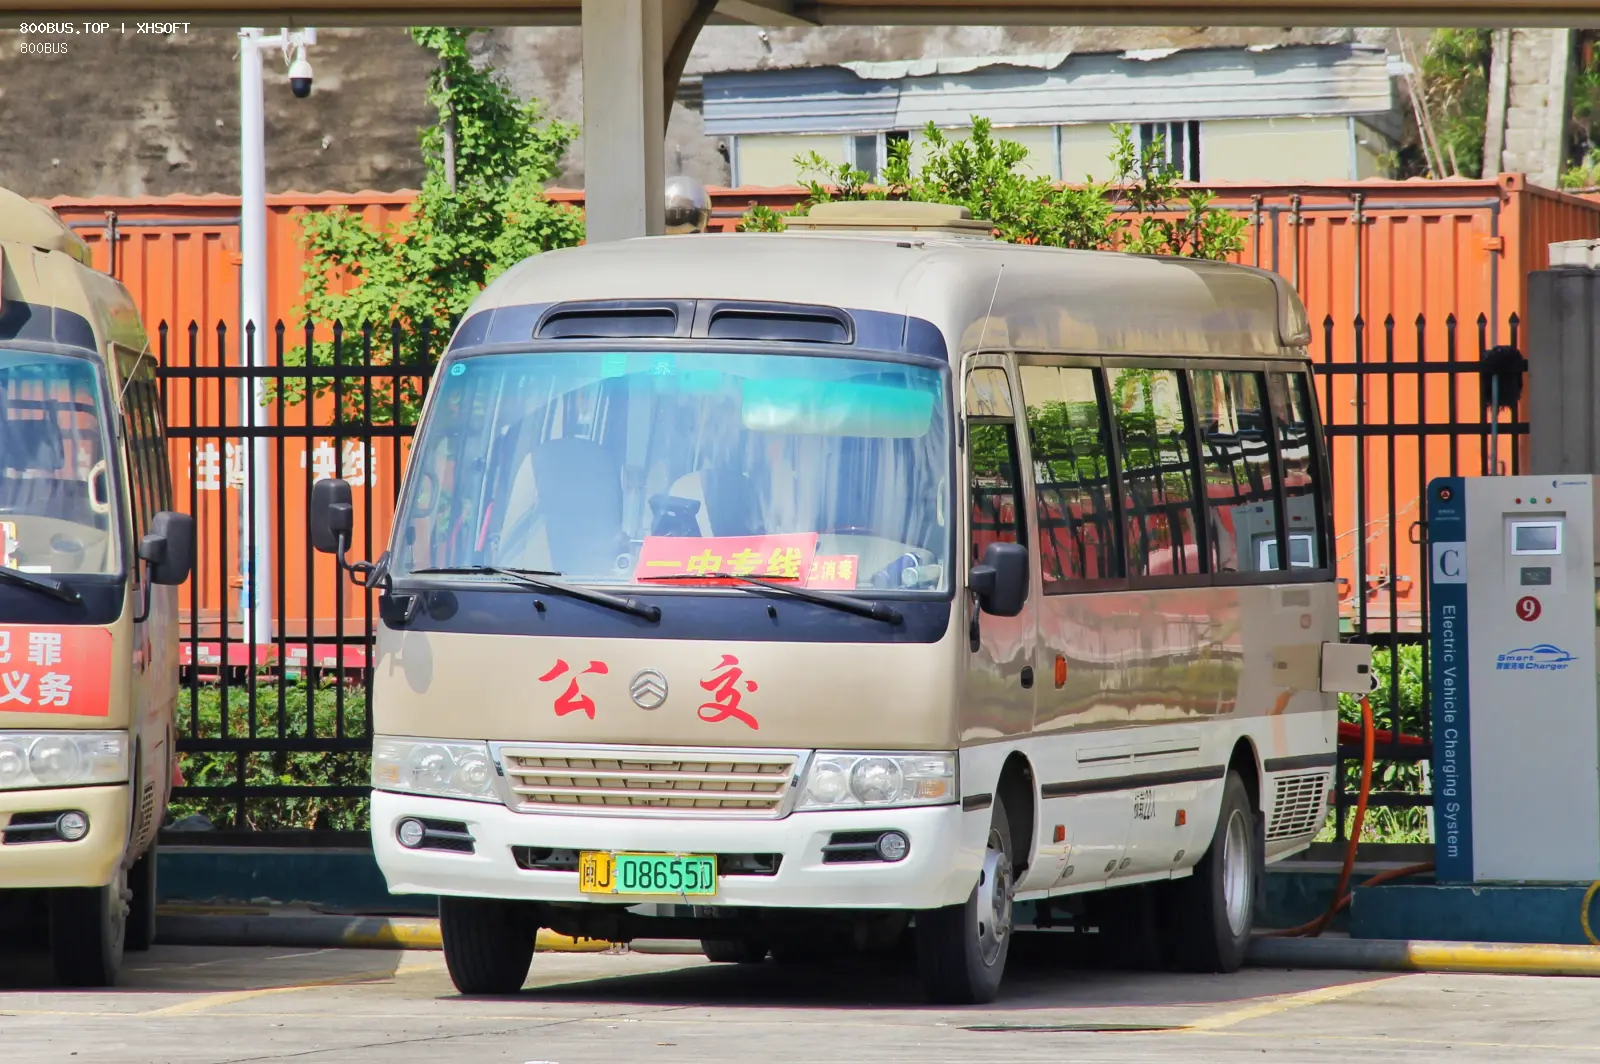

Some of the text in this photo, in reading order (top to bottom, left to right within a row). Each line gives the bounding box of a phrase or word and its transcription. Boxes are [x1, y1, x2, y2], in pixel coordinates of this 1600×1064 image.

[645, 547, 802, 577] 一中专线
[1439, 549, 1460, 577] C
[1522, 600, 1536, 618] 9
[1497, 654, 1535, 662] Smart
[1525, 662, 1569, 671] Charger
[0, 670, 72, 706] 义务
[538, 654, 759, 731] 公 交
[1442, 605, 1461, 857] Electric Vehicle Charging System
[623, 860, 713, 889] 08655D
